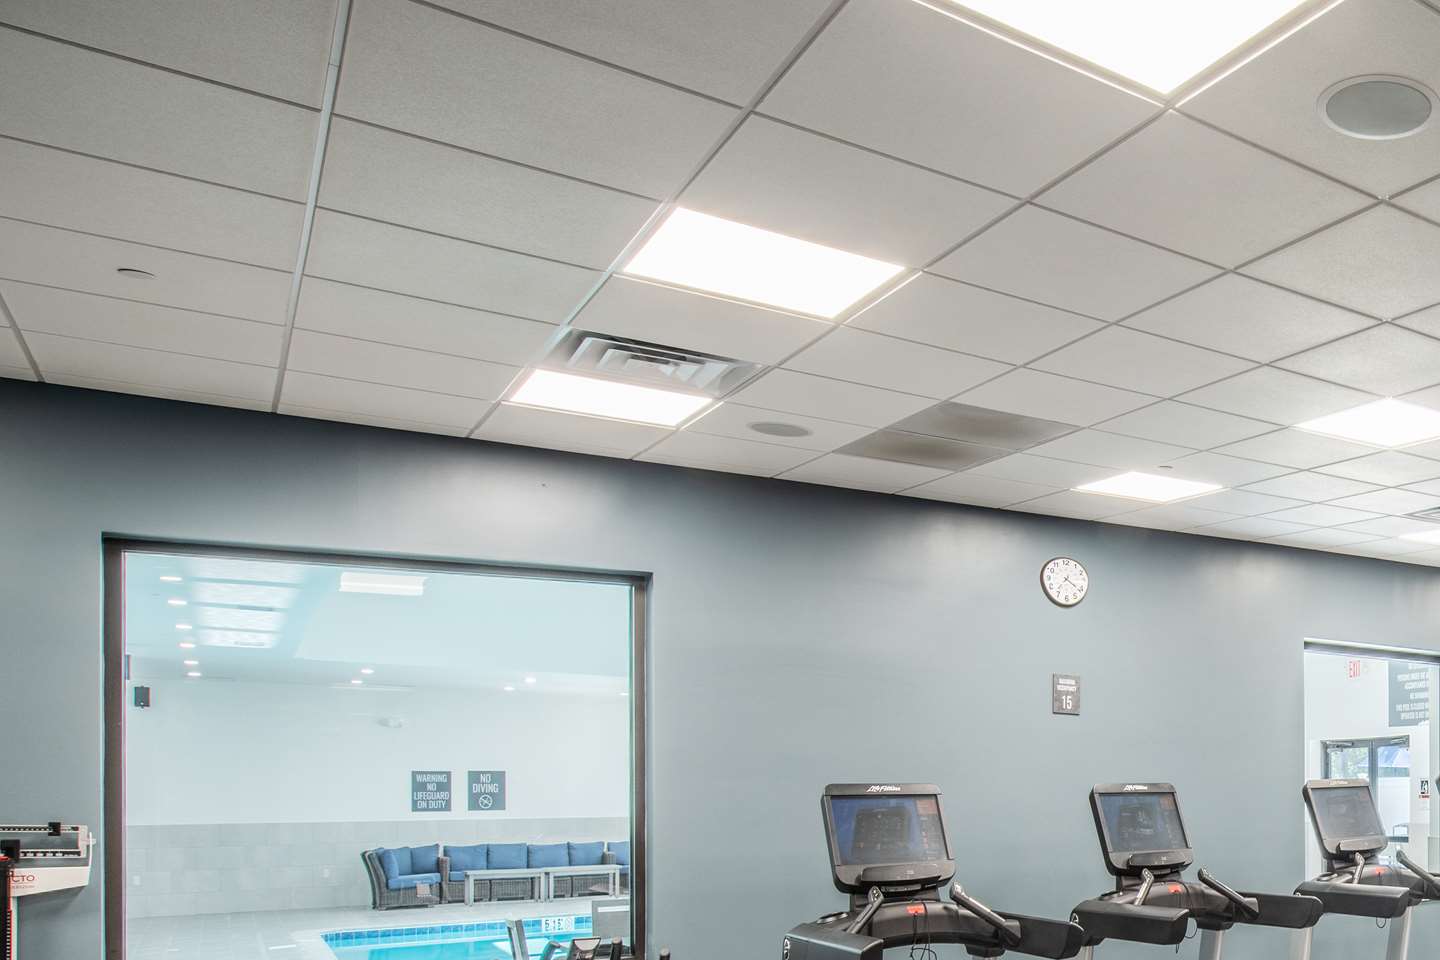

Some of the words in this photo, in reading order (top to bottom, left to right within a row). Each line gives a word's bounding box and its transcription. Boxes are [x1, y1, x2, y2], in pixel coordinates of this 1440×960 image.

[1062, 695, 1073, 710] 15
[416, 774, 448, 783] WARNING
[480, 774, 491, 783] NO
[426, 783, 437, 791] NO
[472, 783, 499, 793] DIVING
[413, 792, 450, 800] LIFEGUARD
[417, 801, 428, 809] ON
